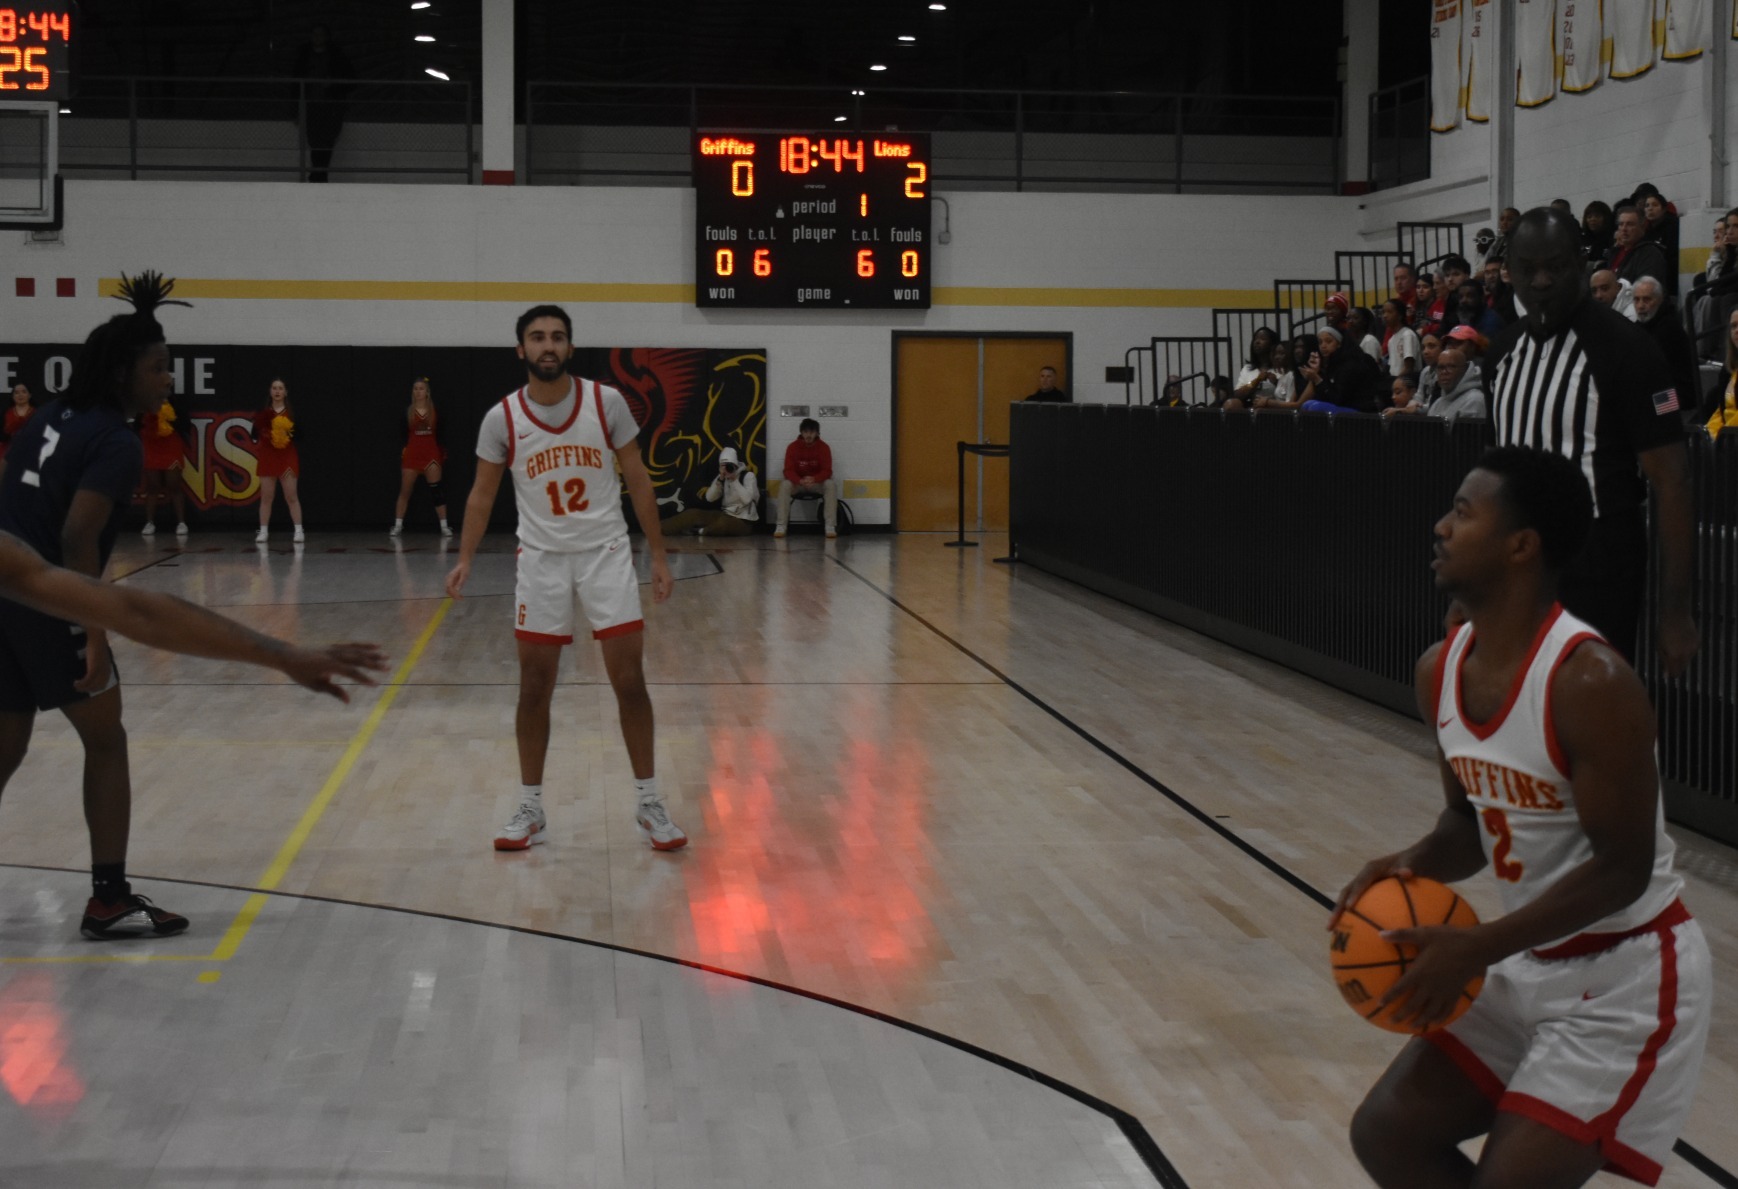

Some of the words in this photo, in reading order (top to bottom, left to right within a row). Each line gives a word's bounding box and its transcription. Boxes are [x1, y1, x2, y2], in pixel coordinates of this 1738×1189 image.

[0, 46, 49, 90] 25
[701, 138, 755, 155] Griffins
[780, 137, 864, 174] 18:44
[874, 140, 912, 157] Lions
[732, 161, 753, 197] 0
[905, 162, 926, 198] 2
[792, 199, 837, 217] period
[860, 193, 868, 217] 1
[706, 226, 738, 241] fouls
[792, 225, 837, 243] player
[891, 227, 922, 242] fouls
[716, 248, 734, 276] 0
[753, 249, 772, 277] 6
[857, 249, 876, 278] 6
[901, 250, 919, 277] 0
[709, 287, 735, 300] won
[797, 287, 831, 303] game
[894, 288, 920, 301] won
[526, 445, 603, 480] GRIFFINS
[545, 477, 590, 516] 12
[518, 604, 527, 626] G
[1450, 756, 1565, 811] RIFFINS
[1480, 806, 1524, 884] 2
